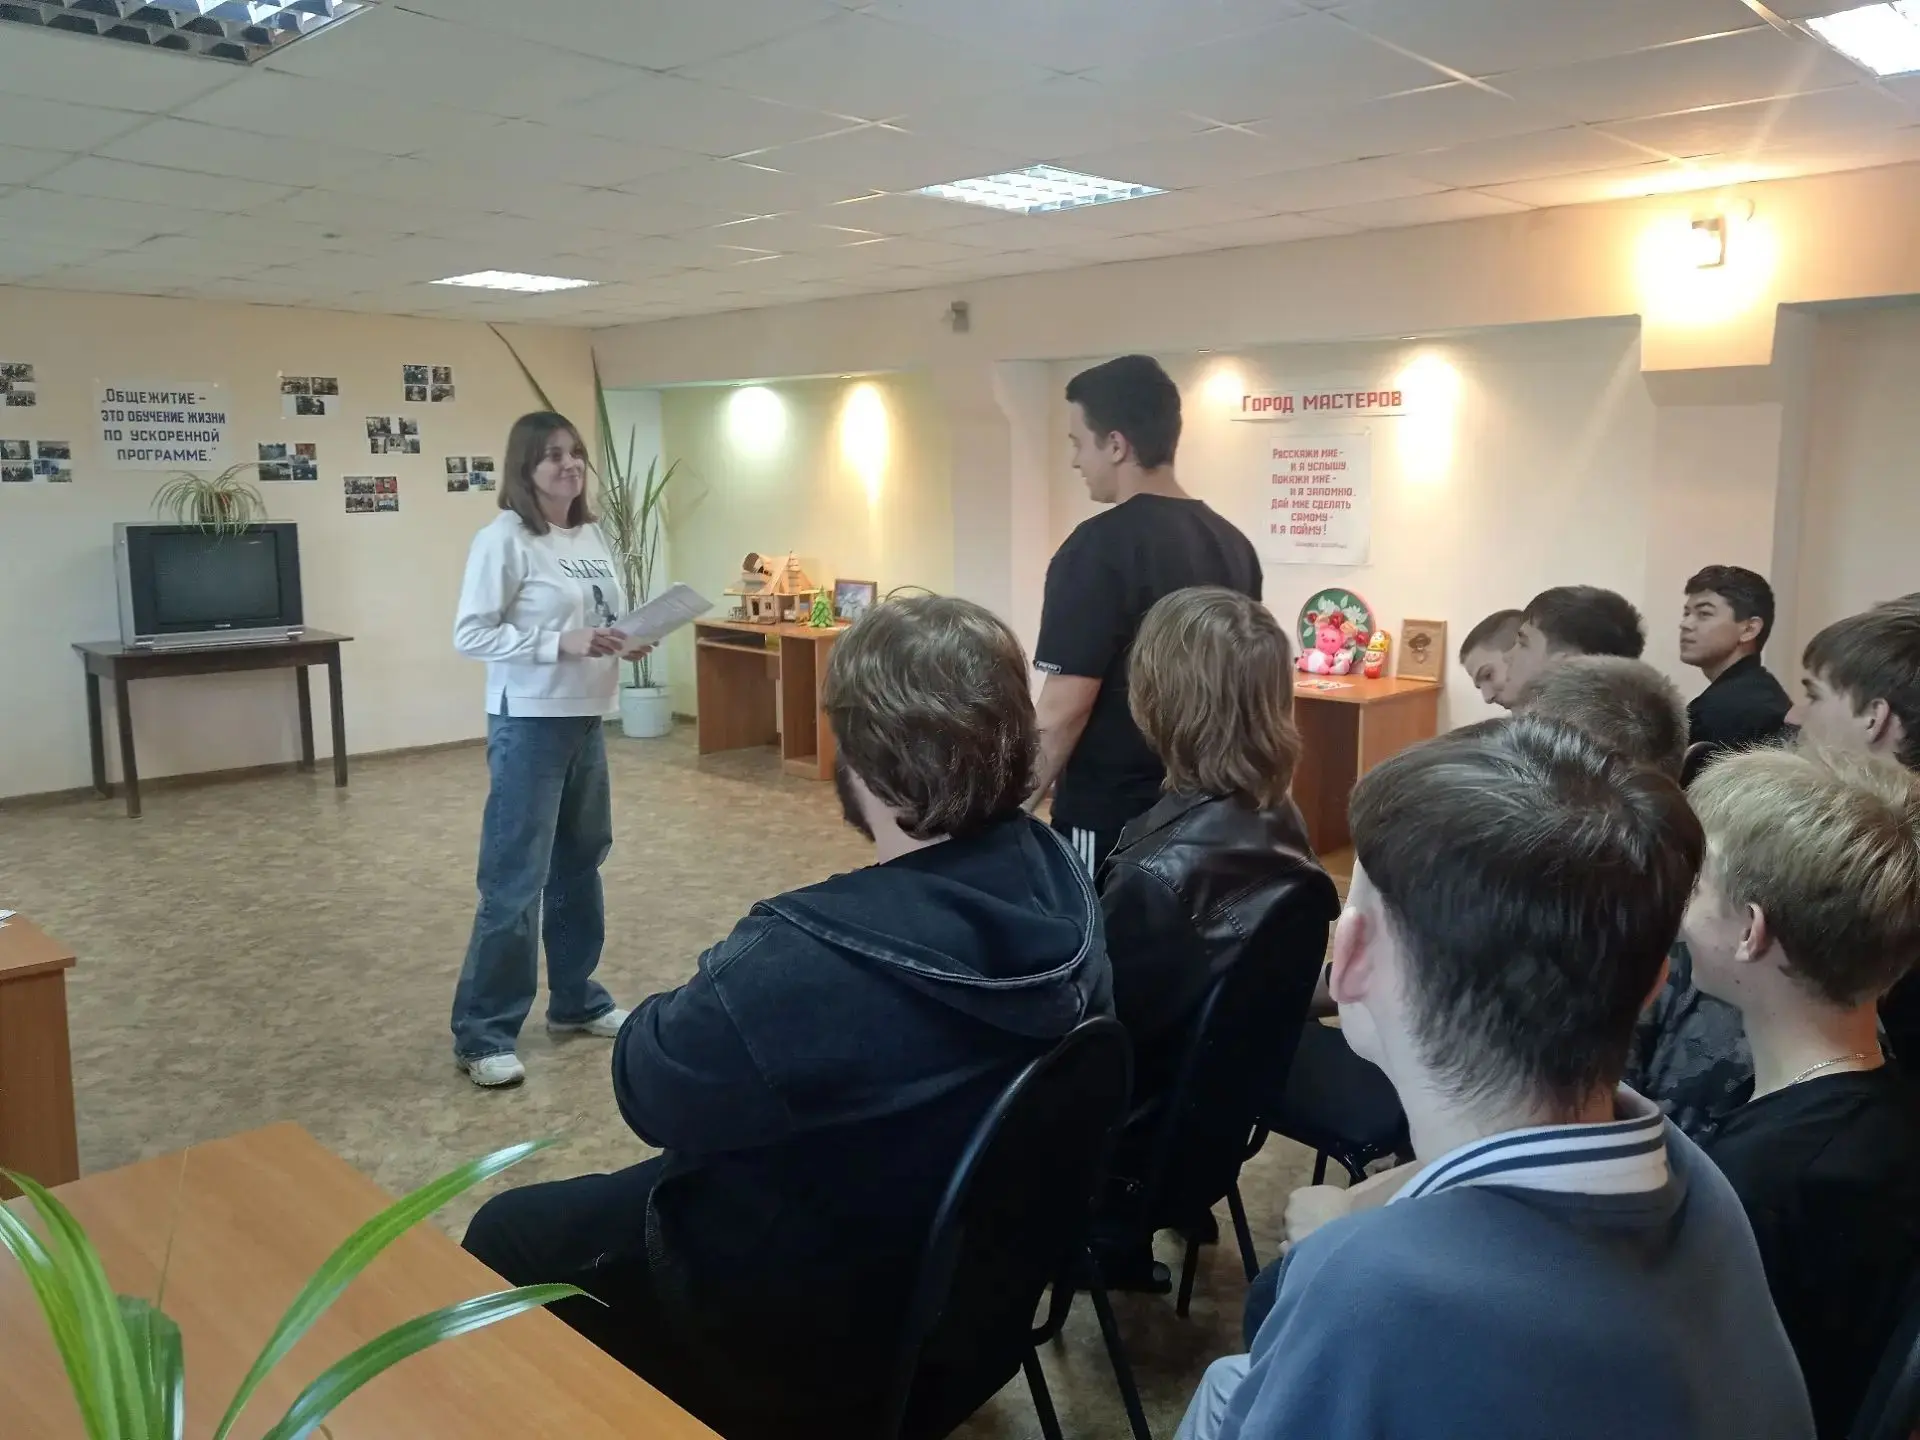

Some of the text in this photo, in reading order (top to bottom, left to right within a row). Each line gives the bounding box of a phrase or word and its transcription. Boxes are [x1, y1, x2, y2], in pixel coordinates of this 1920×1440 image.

[1303, 391, 1403, 410] МАСТЕРОВ
[101, 410, 226, 424] ЭТО ОБУЧЕНИЕ ЖИЗНИ
[104, 428, 220, 442] ПО УСКОРЕННОЙ
[1290, 462, 1297, 472] И
[1299, 462, 1305, 471] Я
[1290, 487, 1297, 496] И
[1298, 487, 1304, 496] Я
[1292, 499, 1310, 509] МНЕ
[1312, 500, 1351, 510] СДЕЛАТЬ
[1291, 512, 1328, 522] САМОМУ
[1279, 525, 1286, 534] Я
[1290, 522, 1327, 536] ПОЙМУ!
